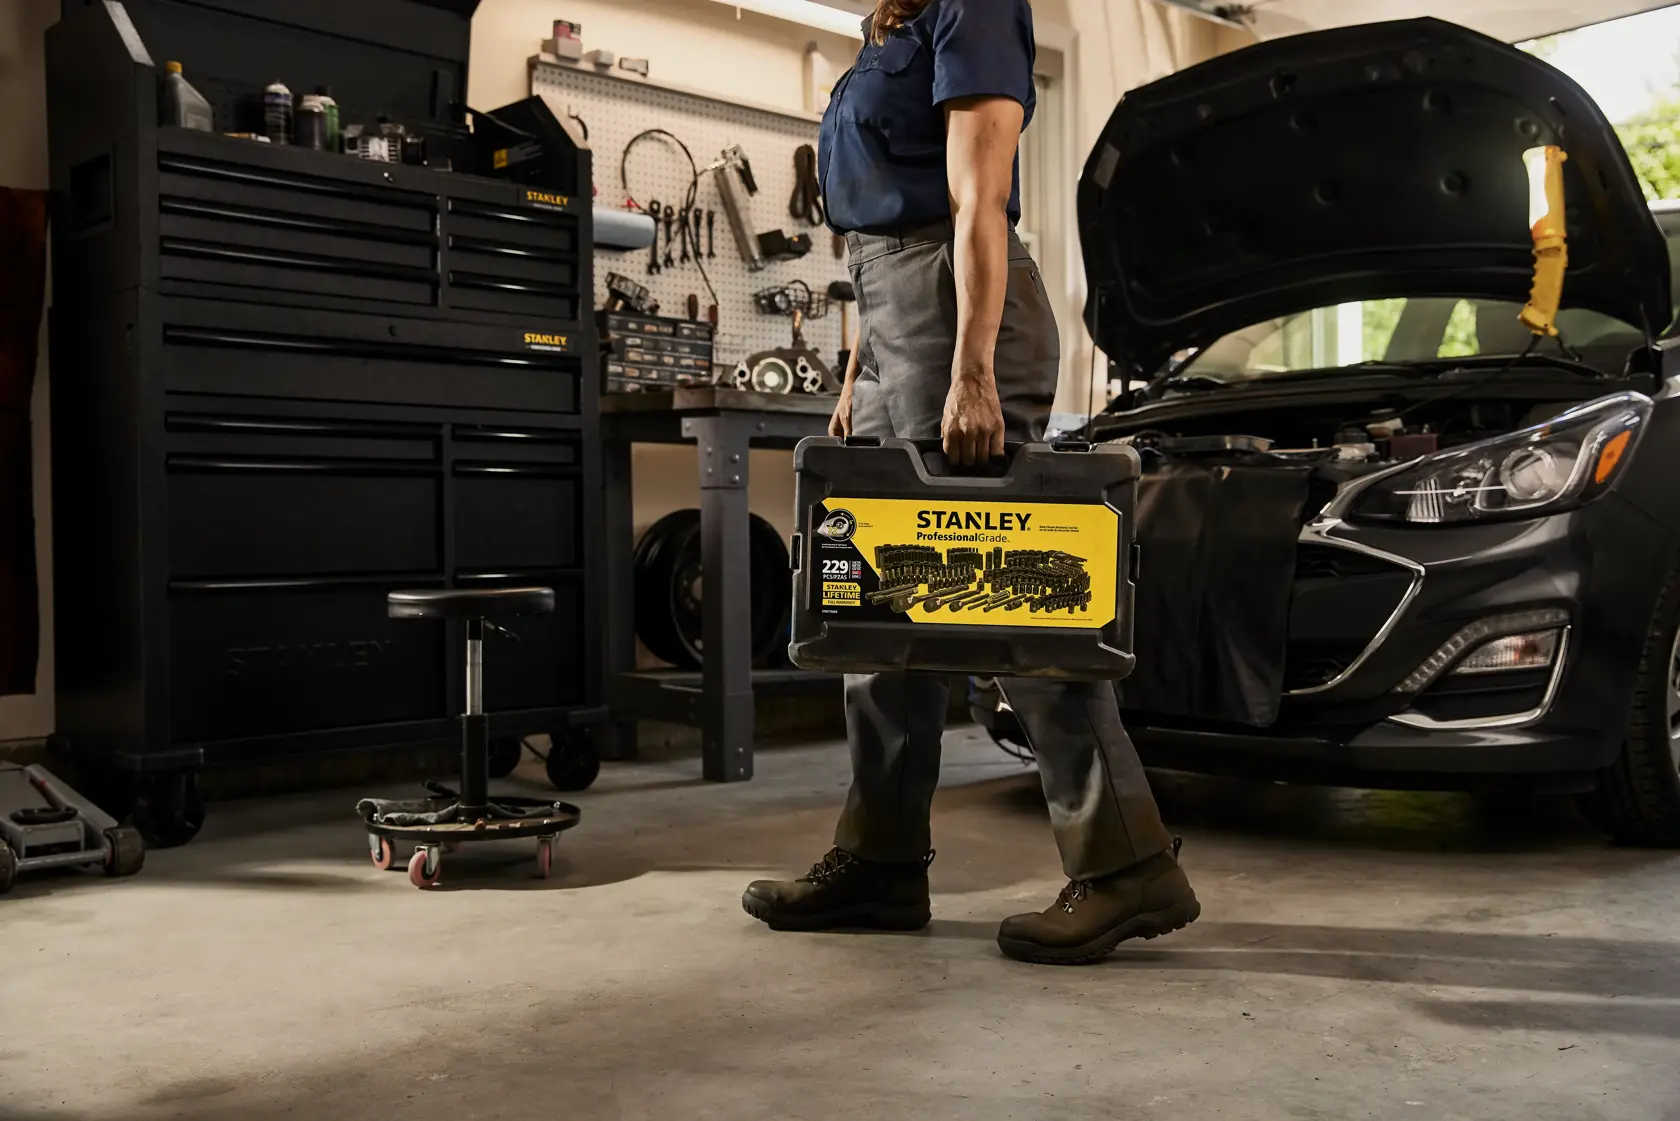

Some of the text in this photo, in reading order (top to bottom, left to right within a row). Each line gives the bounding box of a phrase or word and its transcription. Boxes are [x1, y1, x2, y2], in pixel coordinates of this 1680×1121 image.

[526, 191, 569, 206] STANLEY
[524, 333, 567, 346] STANLEY
[916, 510, 1032, 531] STANLEY
[822, 560, 849, 574] 229
[823, 591, 860, 599] LIFETIME
